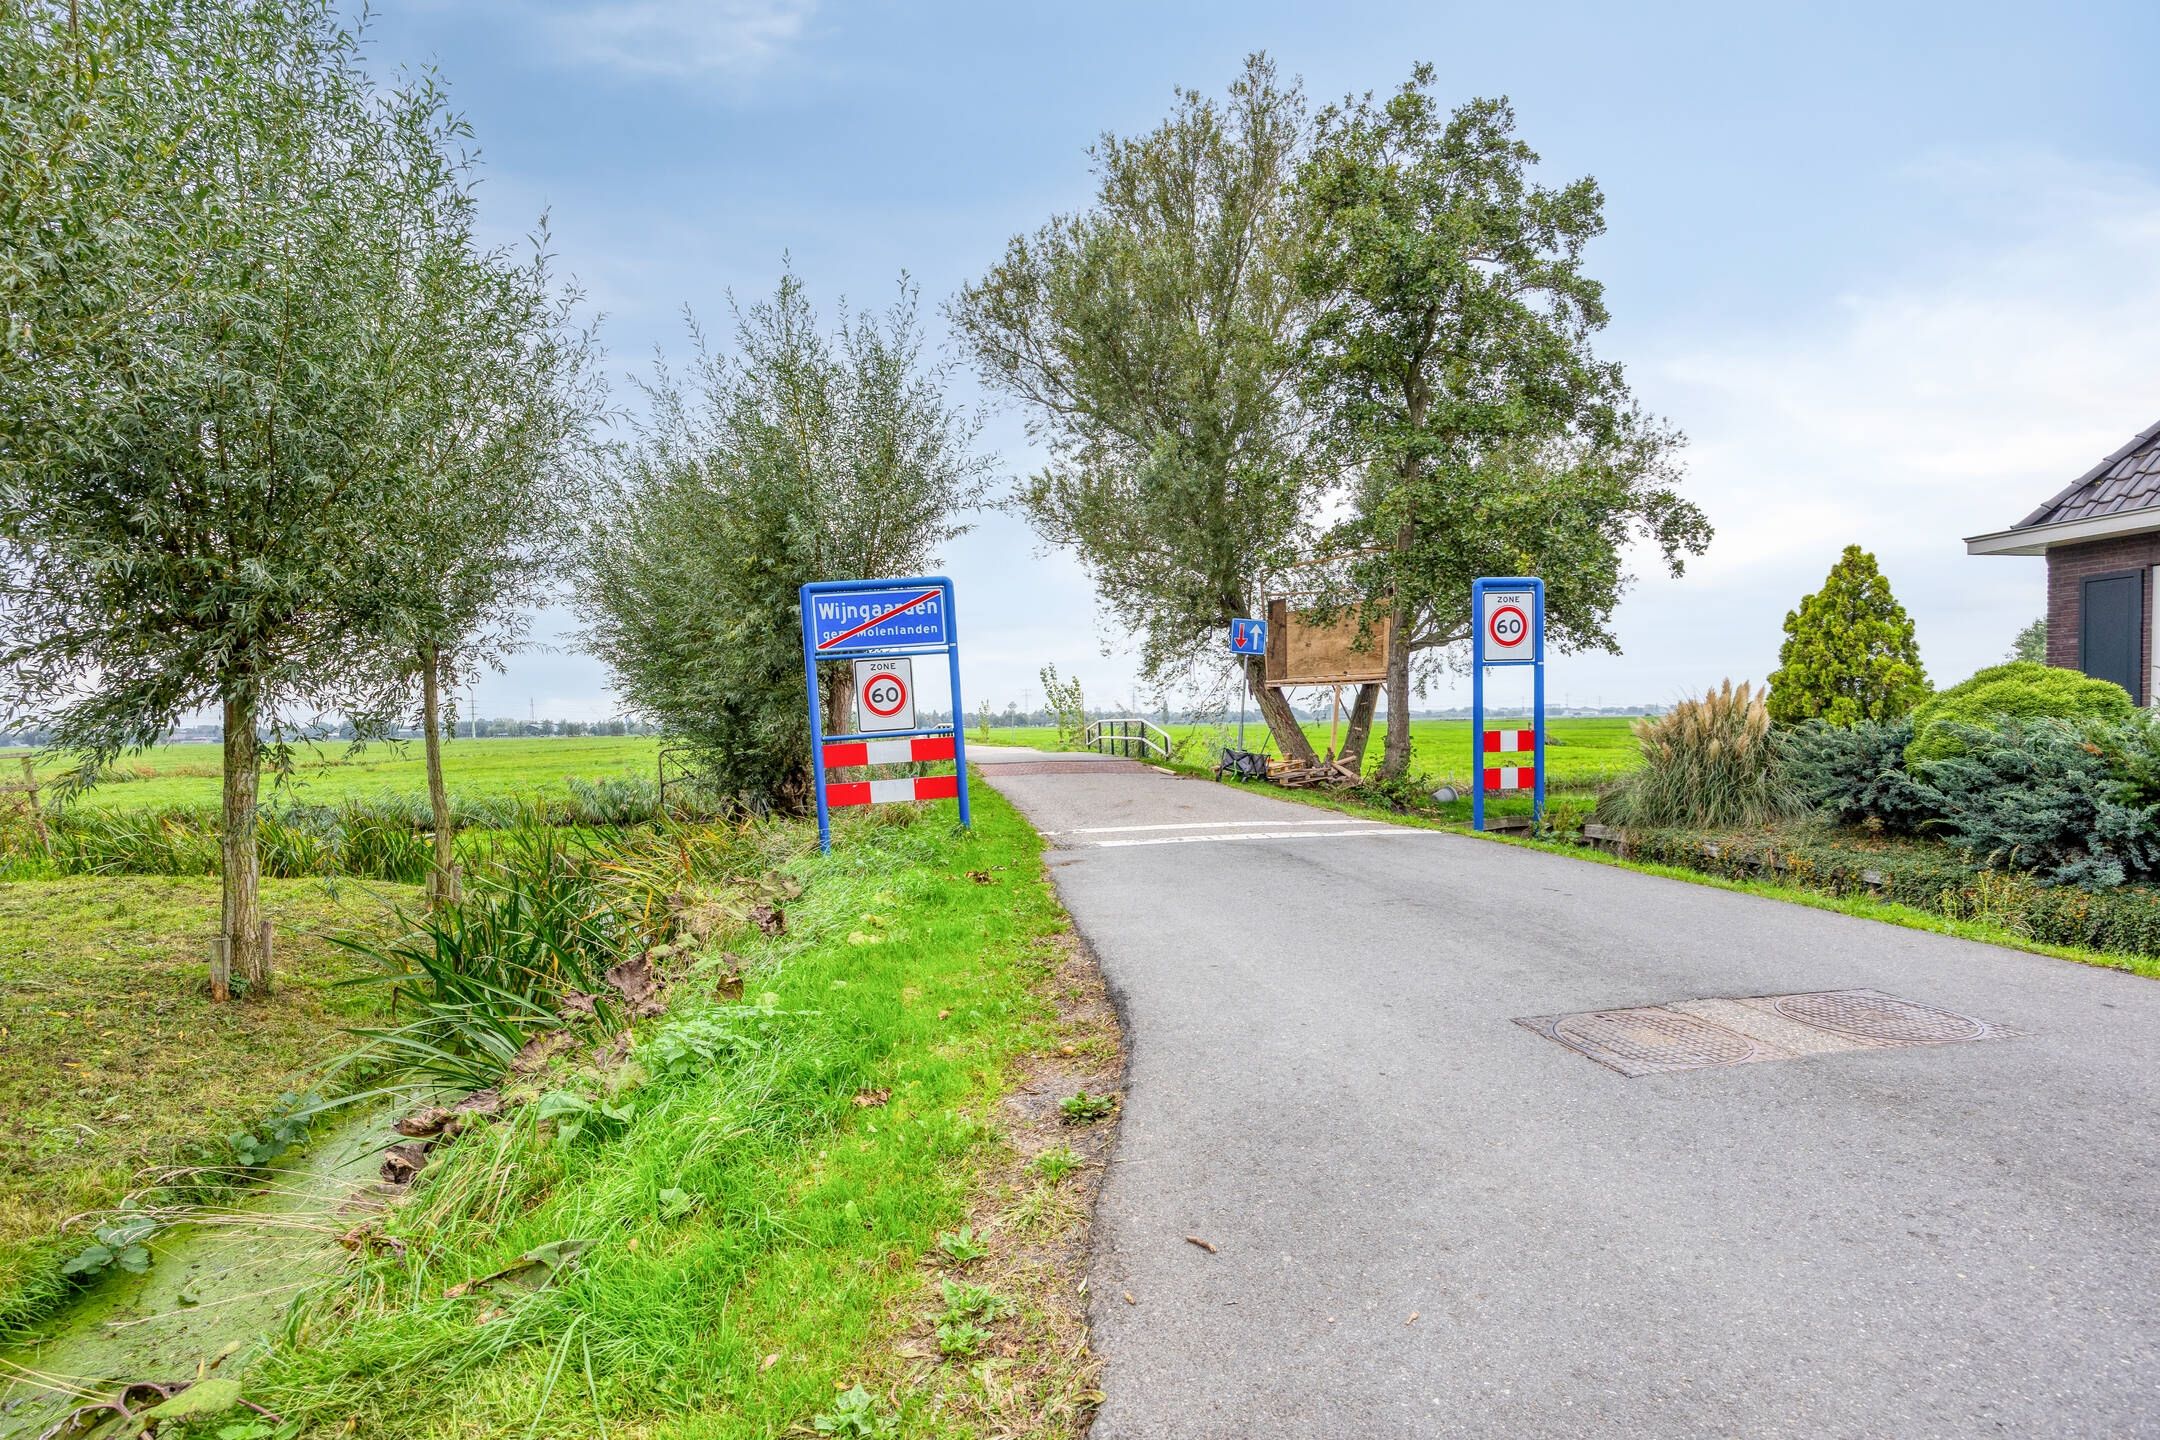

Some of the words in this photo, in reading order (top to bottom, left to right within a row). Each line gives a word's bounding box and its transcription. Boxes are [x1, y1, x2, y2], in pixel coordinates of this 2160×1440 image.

[1497, 619, 1521, 634] 60
[870, 663, 896, 671] ZONE
[872, 687, 899, 703] 60
